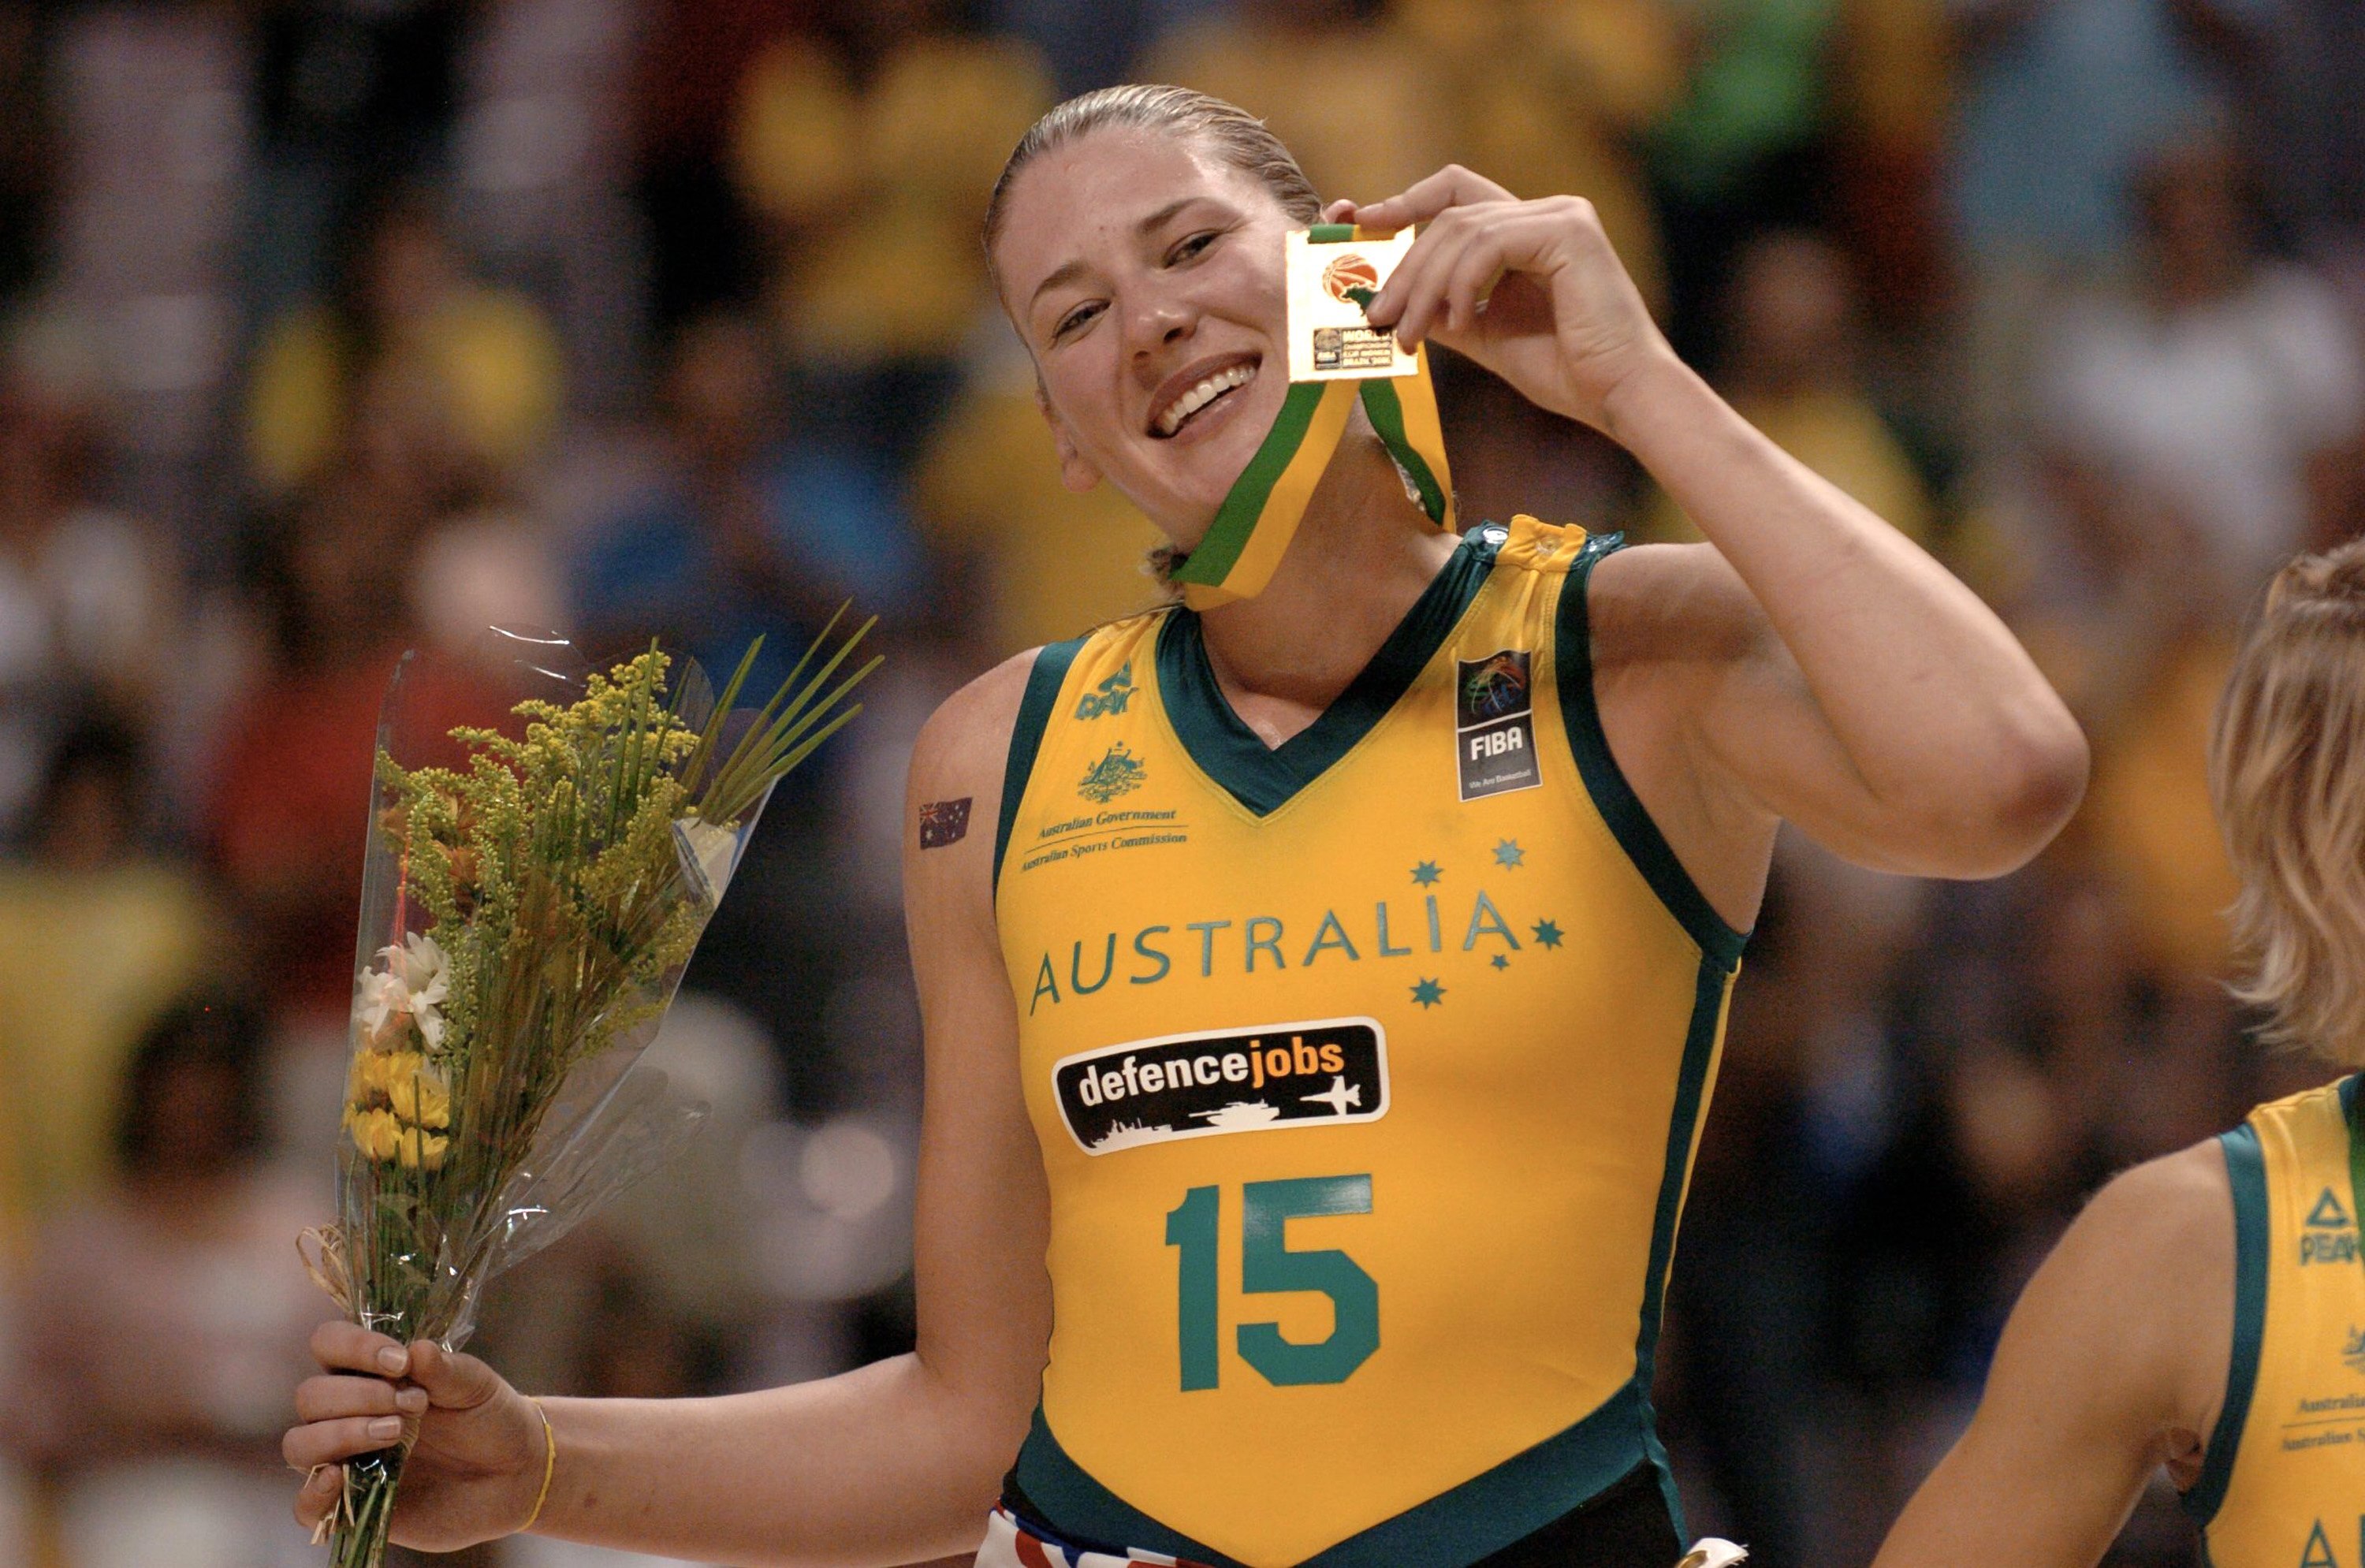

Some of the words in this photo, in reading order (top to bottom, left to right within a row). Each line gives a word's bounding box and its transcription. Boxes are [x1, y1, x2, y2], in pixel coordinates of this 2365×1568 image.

[1470, 726, 1523, 761] FIBA
[1038, 816, 1093, 840] Australian
[1096, 809, 1177, 825] Government
[1021, 850, 1068, 872] Australian
[1070, 841, 1108, 858] Sports
[1111, 833, 1187, 850] Commission
[1030, 889, 1522, 1017] AUSTRALIA
[1078, 1036, 1345, 1106] defencejobs
[1165, 1173, 1380, 1392] 15
[2296, 1393, 2365, 1414] Australia
